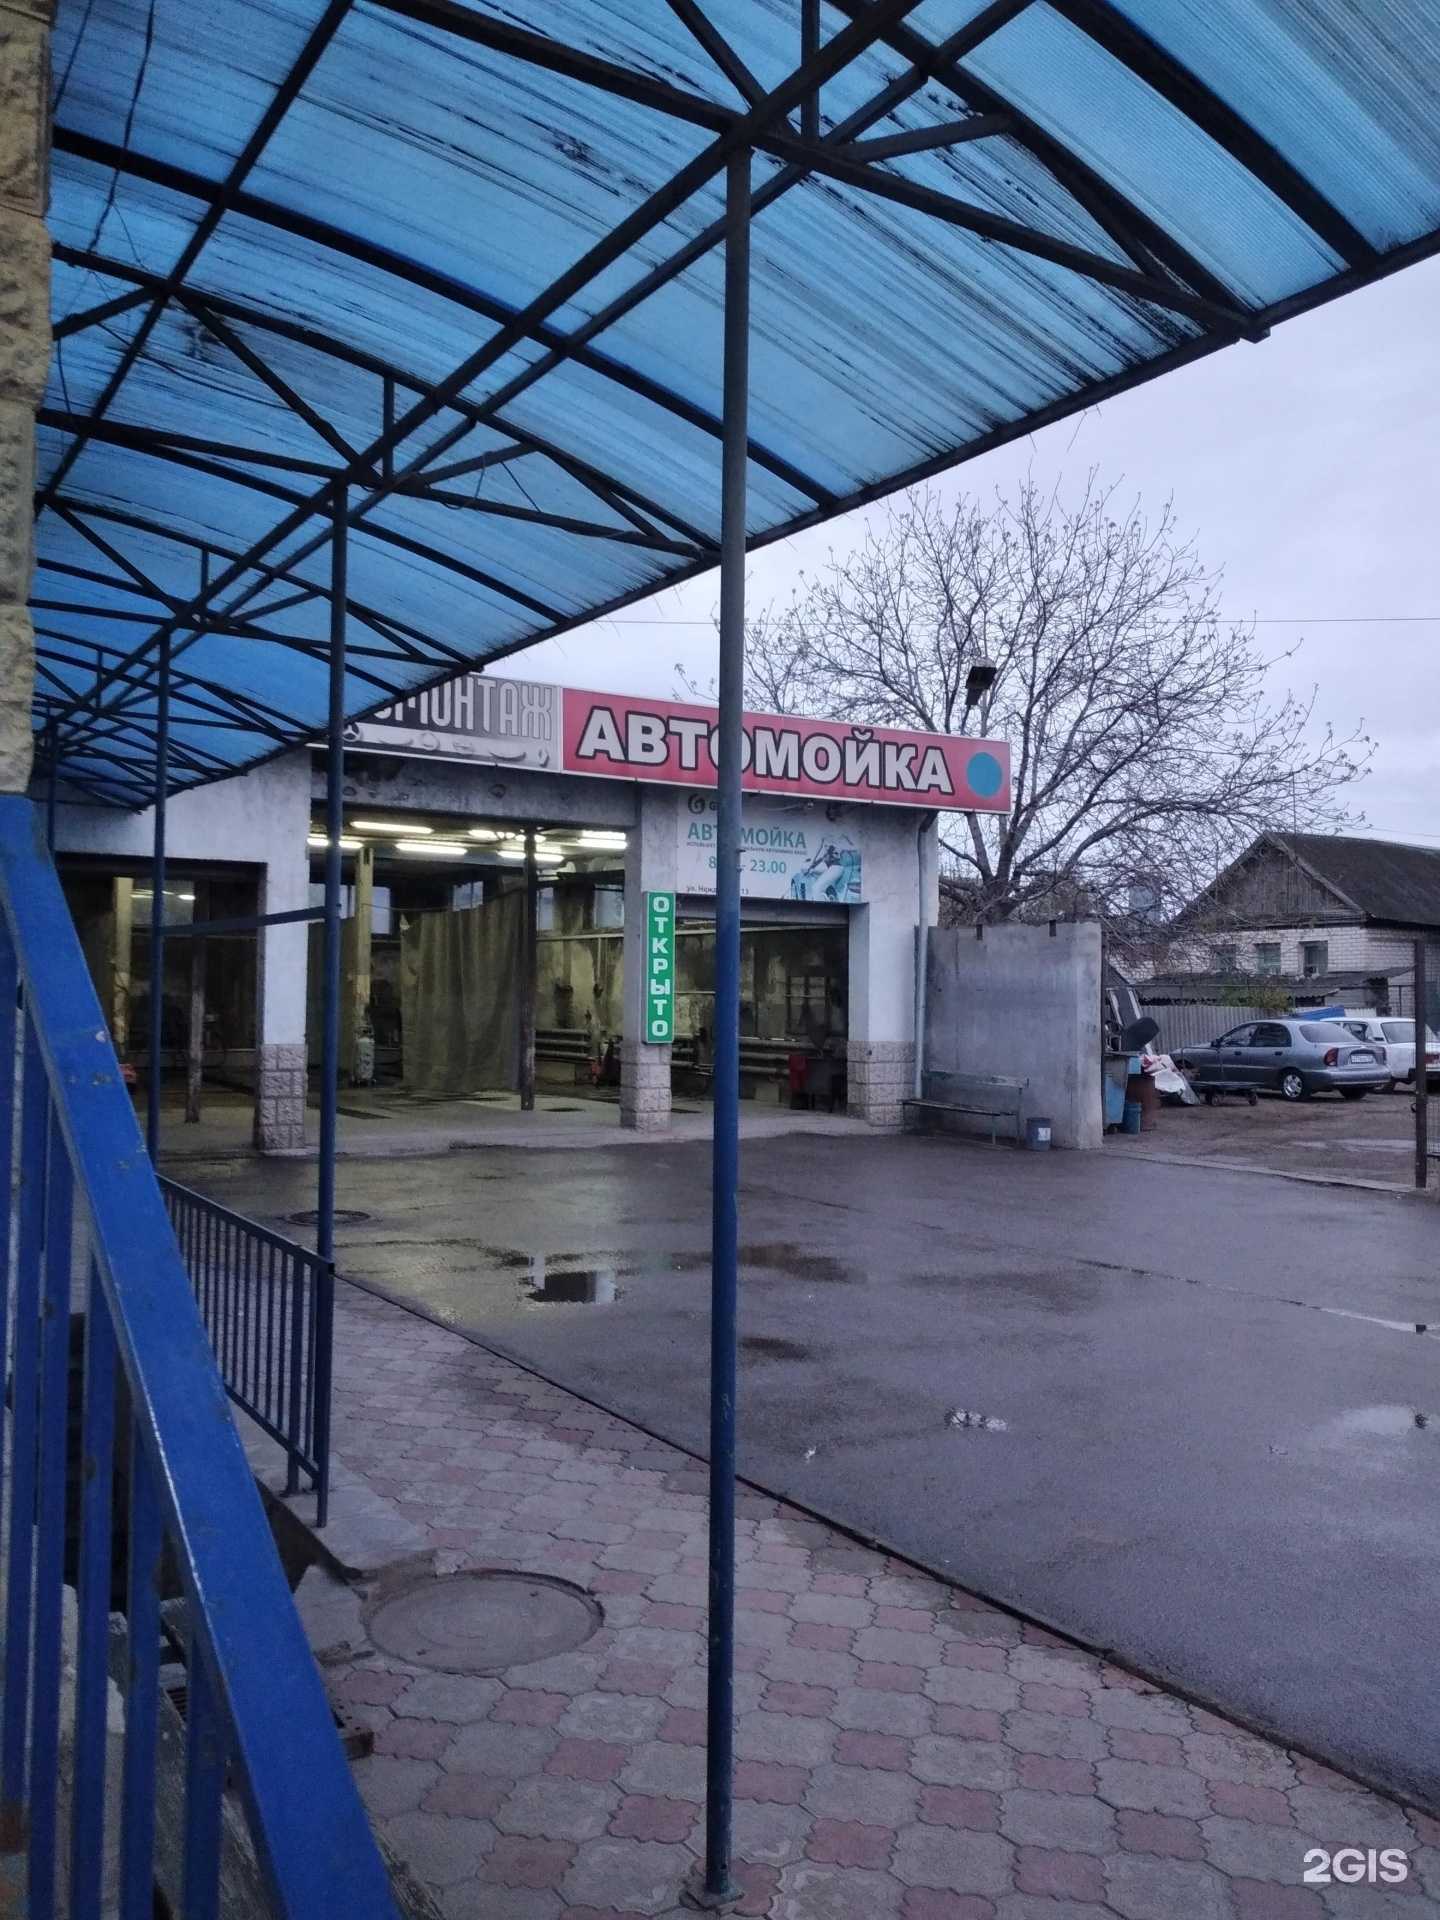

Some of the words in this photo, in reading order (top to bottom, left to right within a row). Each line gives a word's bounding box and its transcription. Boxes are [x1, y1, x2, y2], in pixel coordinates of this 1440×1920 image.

[687, 822, 807, 849] АВМОЙКА
[750, 859, 787, 874] 23.00
[650, 896, 671, 1037] ОТКРЫТО
